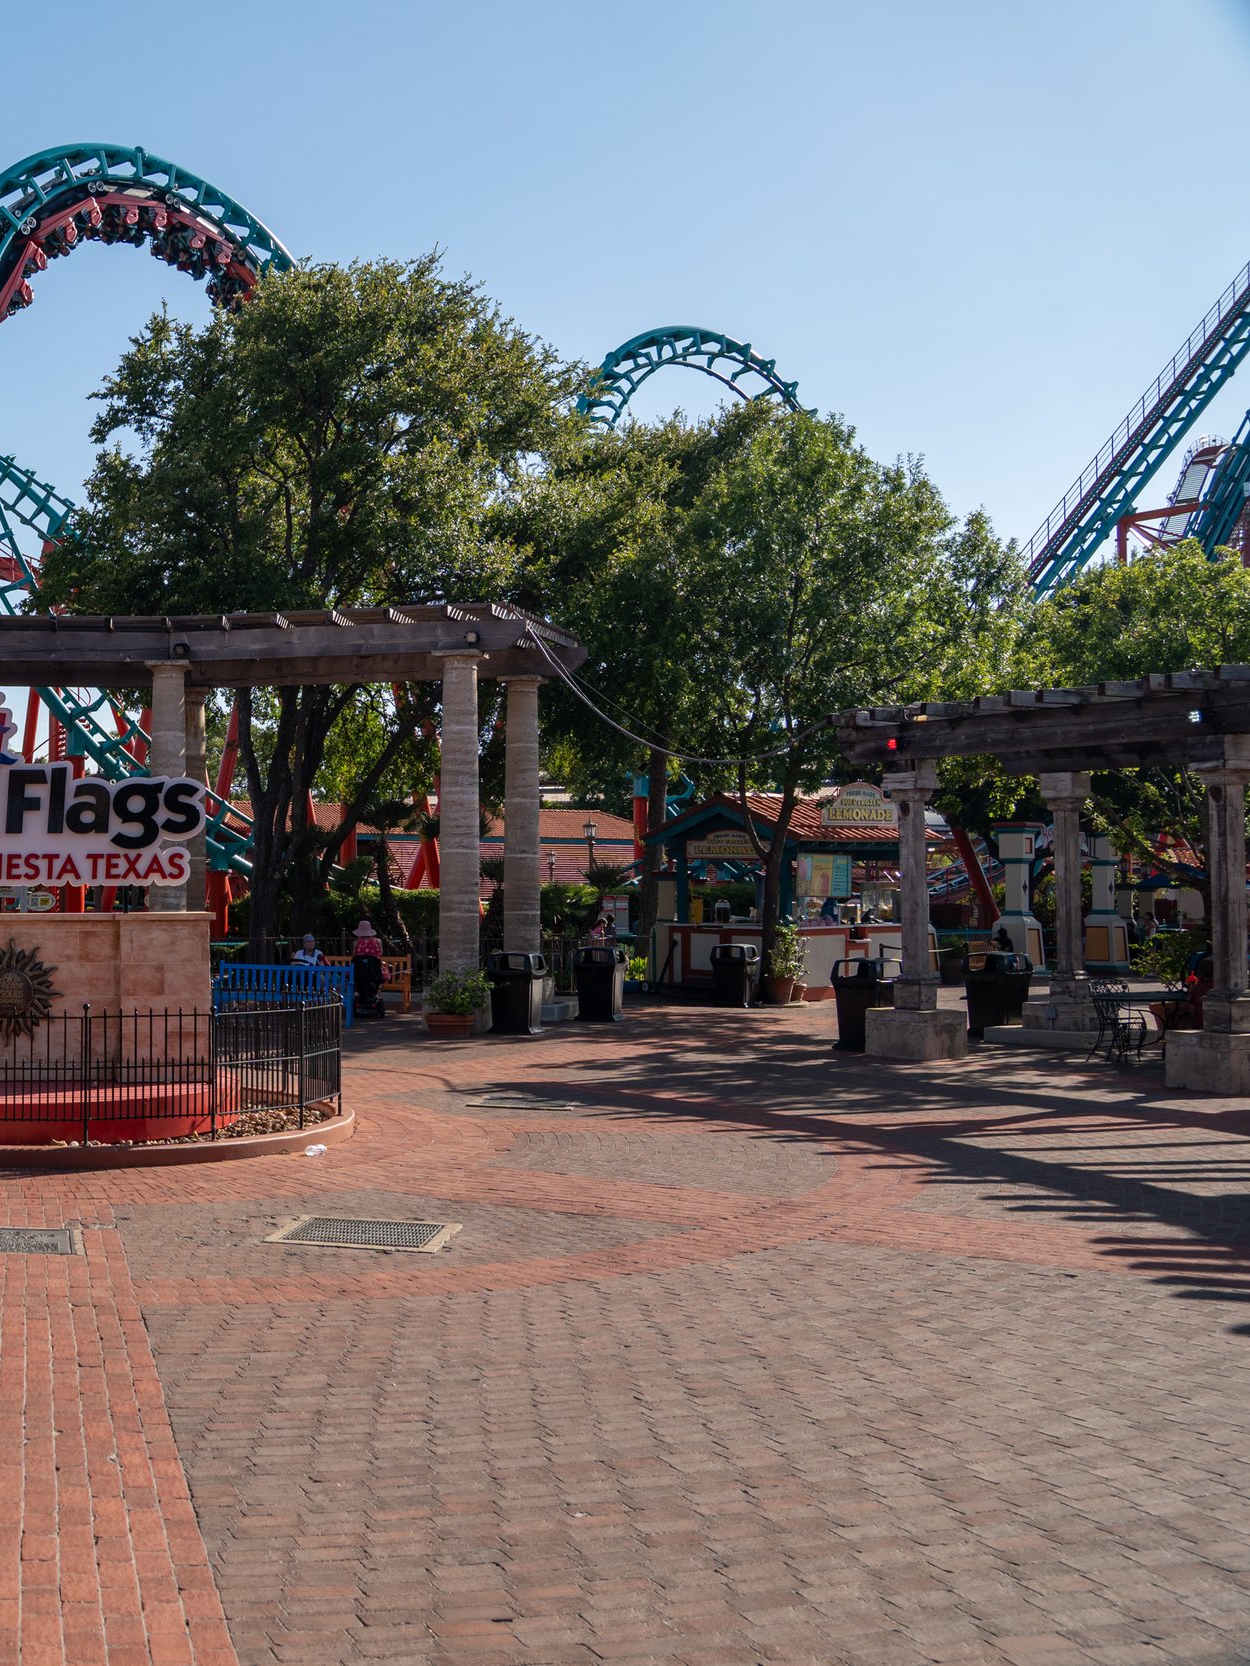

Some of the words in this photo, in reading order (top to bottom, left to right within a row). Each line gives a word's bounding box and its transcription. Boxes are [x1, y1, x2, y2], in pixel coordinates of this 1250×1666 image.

[5, 767, 200, 849] Flags
[828, 808, 894, 822] LEMONADE
[694, 845, 756, 855] LEMONAD
[86, 853, 185, 880] TEXAS
